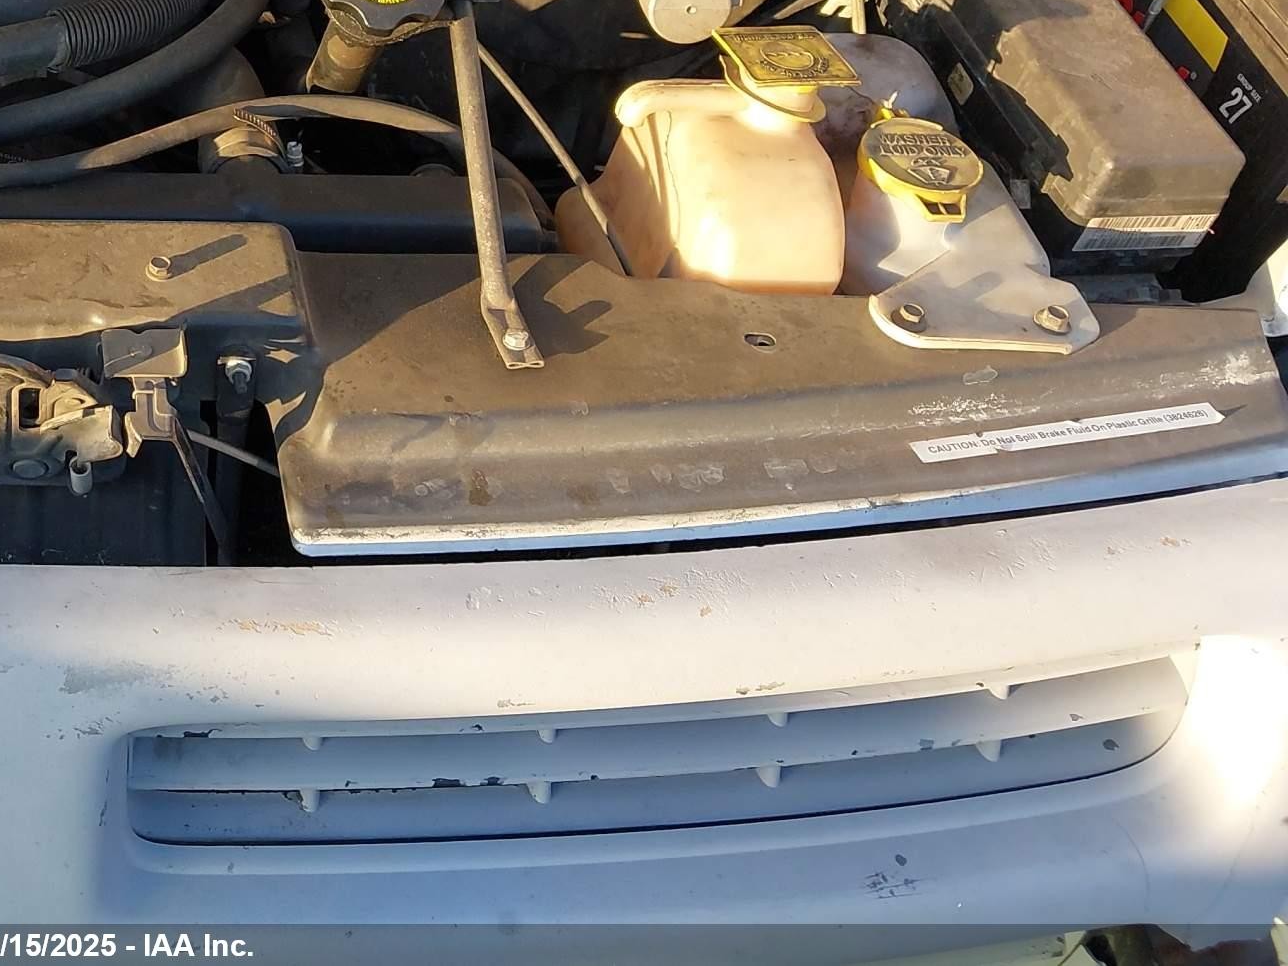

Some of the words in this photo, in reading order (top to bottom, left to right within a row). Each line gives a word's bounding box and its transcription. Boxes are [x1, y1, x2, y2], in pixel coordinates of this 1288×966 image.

[1219, 87, 1253, 124] 27
[874, 145, 918, 156] LUID
[923, 146, 965, 157] ONLY
[878, 133, 950, 146] WASHER
[928, 440, 981, 454] CAUTION:
[981, 438, 996, 446] Do
[1017, 432, 1038, 443] Spill
[1038, 430, 1067, 440] Brake
[1068, 426, 1093, 435] Fluid
[1092, 424, 1107, 432] On
[1108, 420, 1137, 430] Plastic
[1138, 415, 1163, 426] Grille
